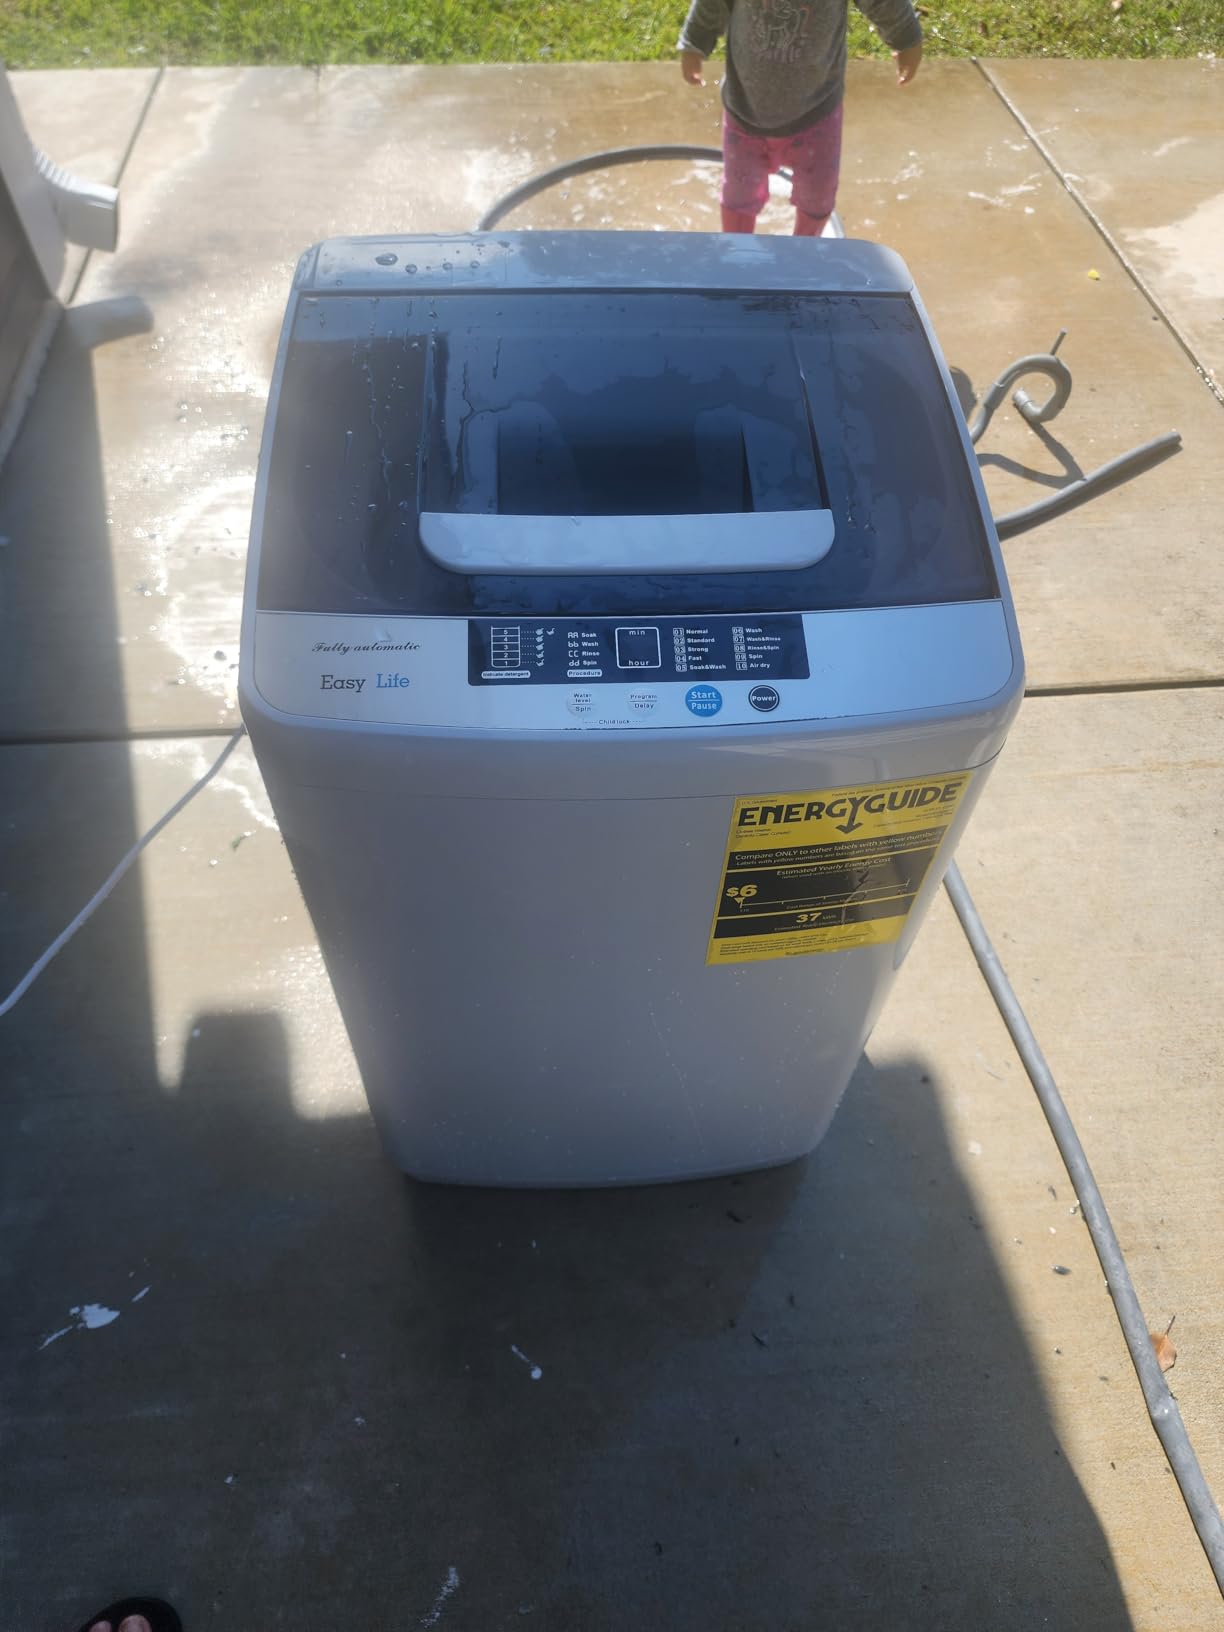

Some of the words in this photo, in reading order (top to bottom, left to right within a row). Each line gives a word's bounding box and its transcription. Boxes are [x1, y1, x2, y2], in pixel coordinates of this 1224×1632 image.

[312, 642, 351, 655] Fully
[353, 641, 421, 652] automatic
[320, 674, 366, 693] Easy
[376, 672, 410, 688] Life
[691, 691, 717, 699] Start
[691, 702, 717, 710] Pause
[738, 782, 963, 833] ENERGYGUIDE
[735, 852, 774, 861] Compare
[775, 850, 798, 858] ONLY
[809, 846, 833, 854] other
[833, 842, 858, 851] labels
[859, 840, 878, 848] with
[879, 836, 906, 846] yellow
[776, 867, 817, 876] Estimated
[818, 863, 843, 872] Yearly
[726, 884, 759, 898] $6
[795, 912, 822, 924] 37
